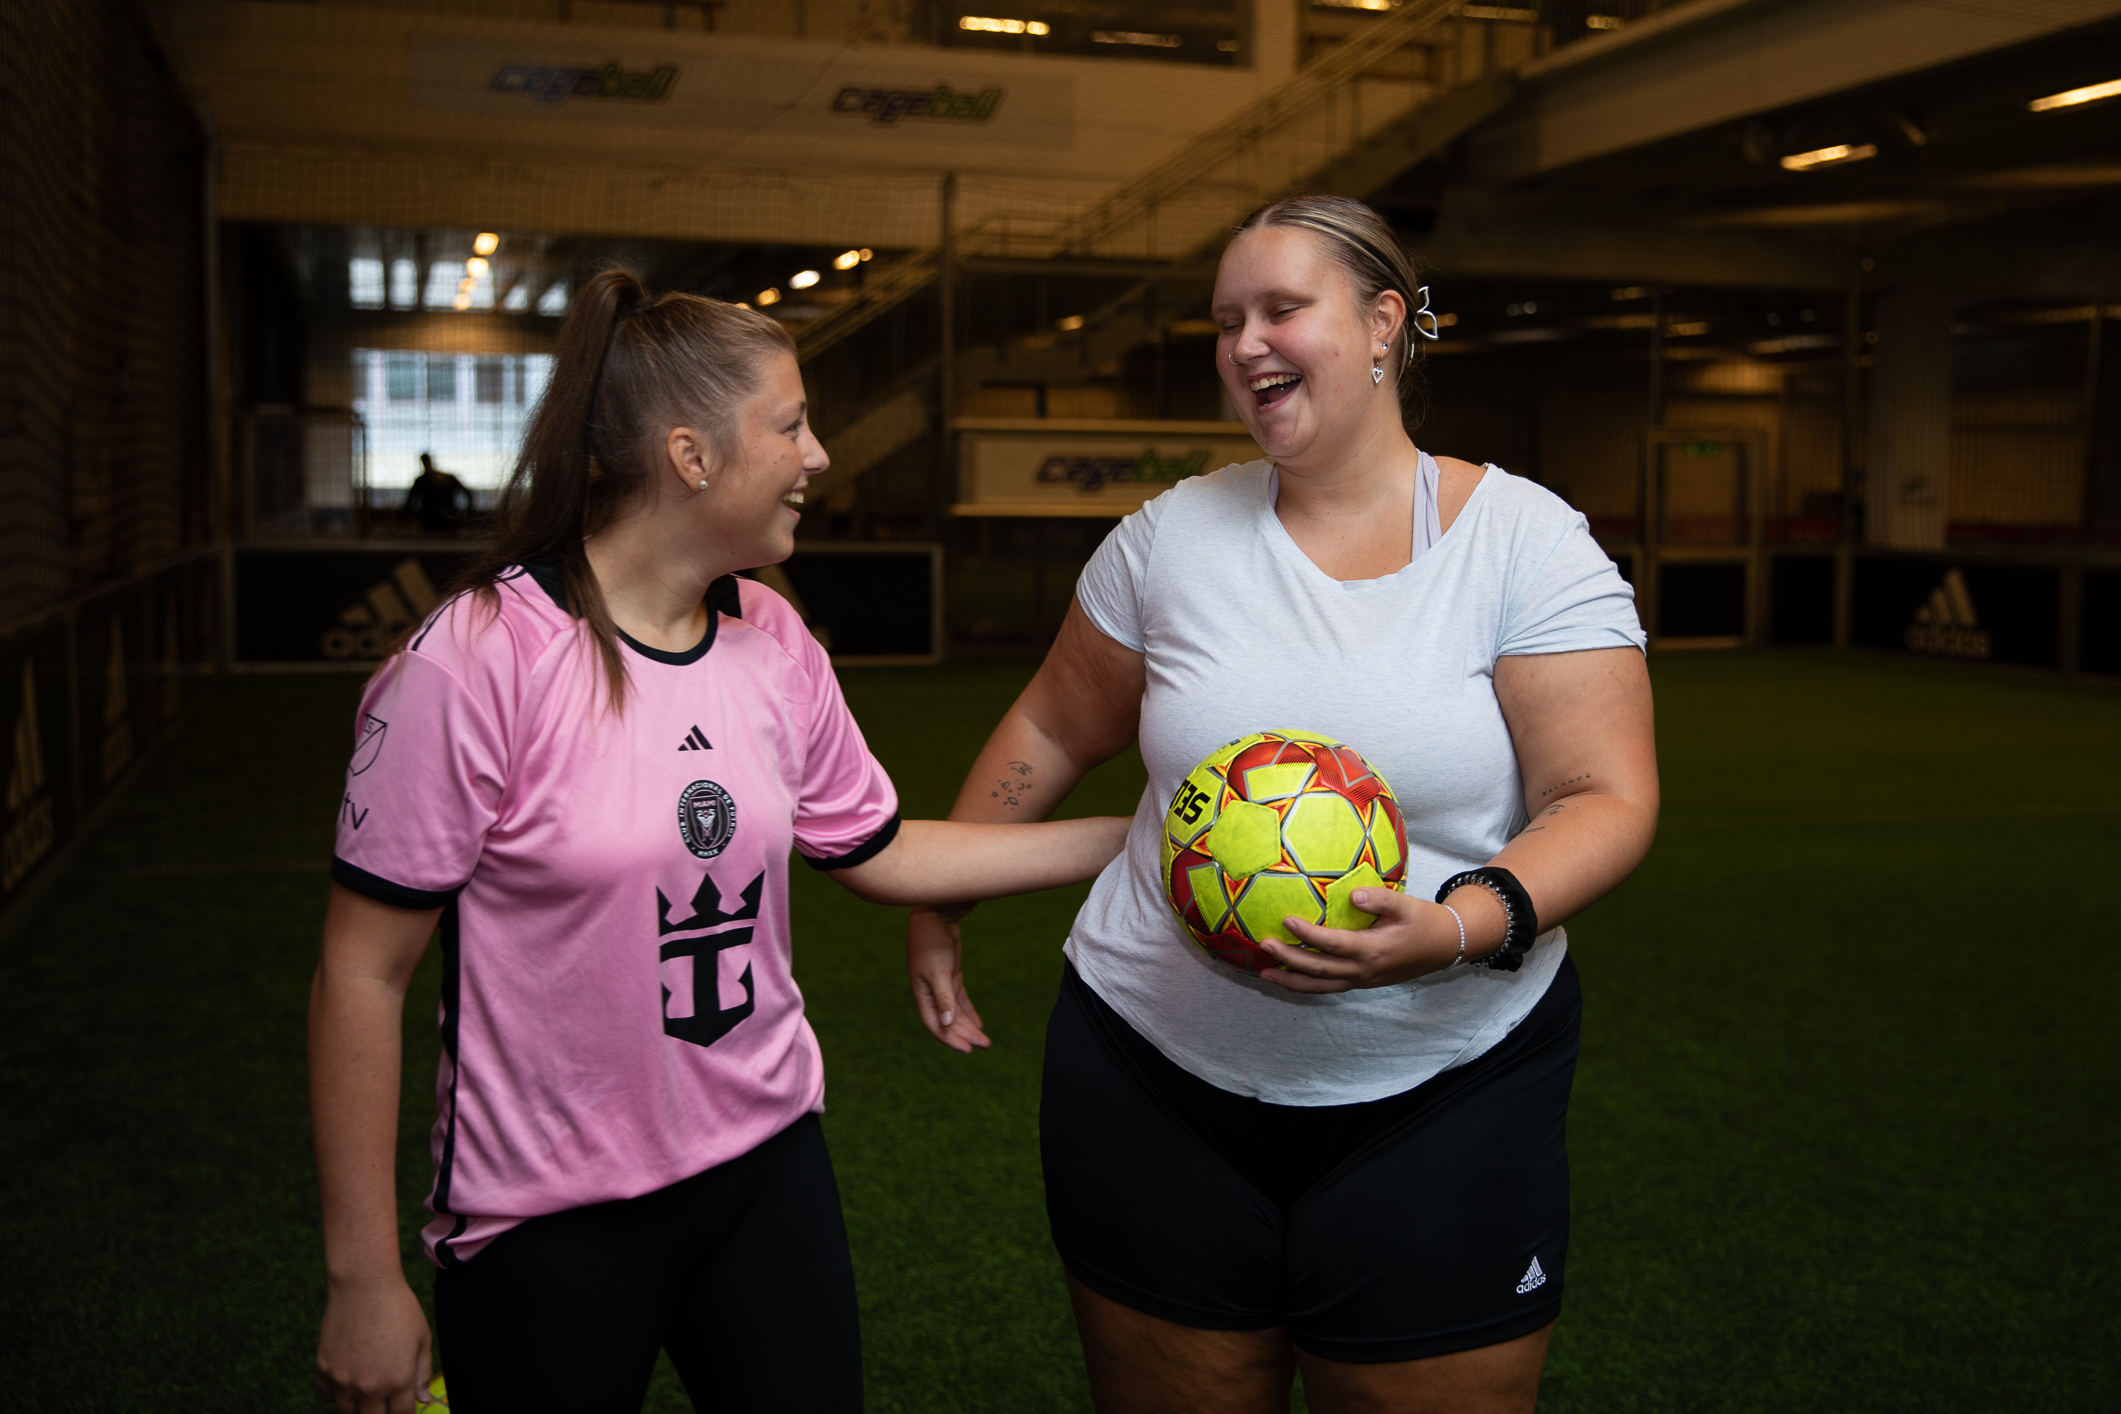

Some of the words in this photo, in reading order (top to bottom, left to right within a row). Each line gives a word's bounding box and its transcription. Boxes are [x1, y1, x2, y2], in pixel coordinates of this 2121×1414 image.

[832, 84, 1002, 125] cageball
[693, 800, 717, 808] MIAMI
[722, 794, 732, 805] DE
[1515, 1273, 1548, 1295] adidas
